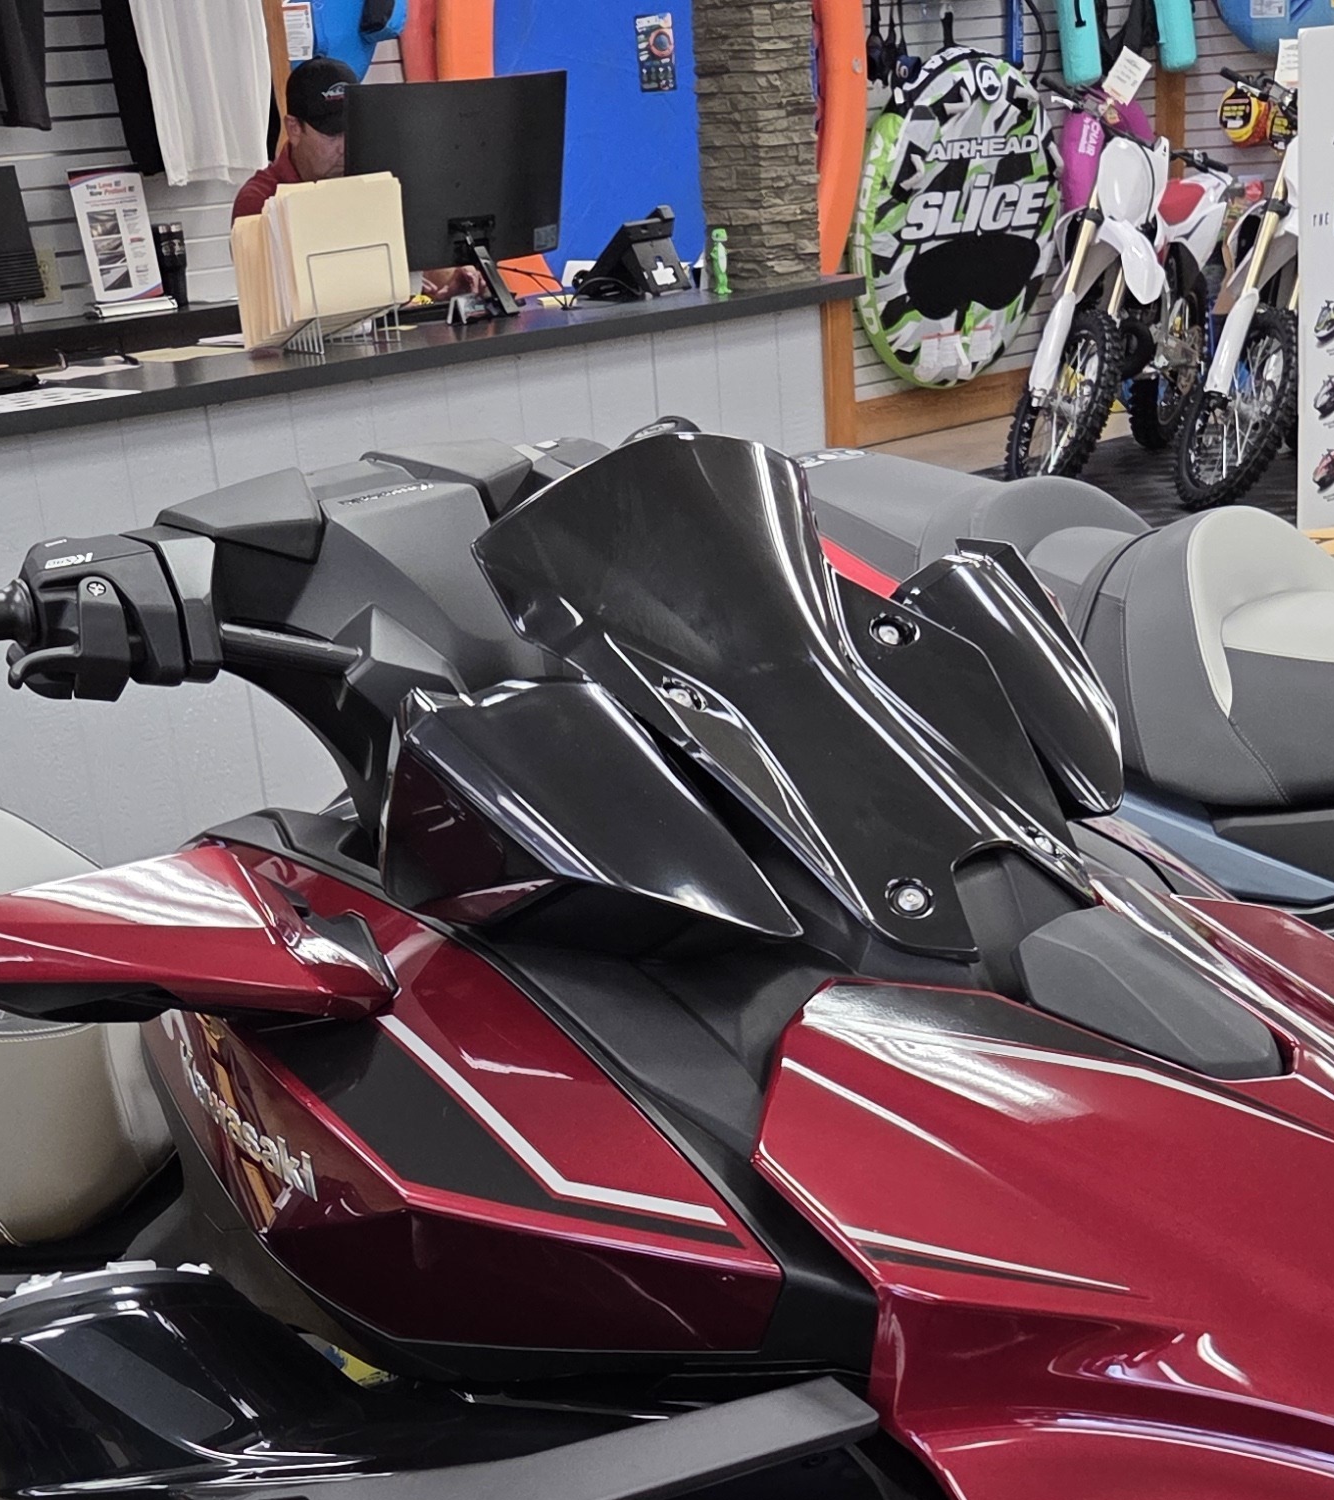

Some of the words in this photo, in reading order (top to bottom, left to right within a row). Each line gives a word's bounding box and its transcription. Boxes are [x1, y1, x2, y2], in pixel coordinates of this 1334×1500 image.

[925, 134, 1040, 163] AIRHEAD
[1313, 211, 1330, 227] THE
[180, 1040, 318, 1202] Kawasaki
